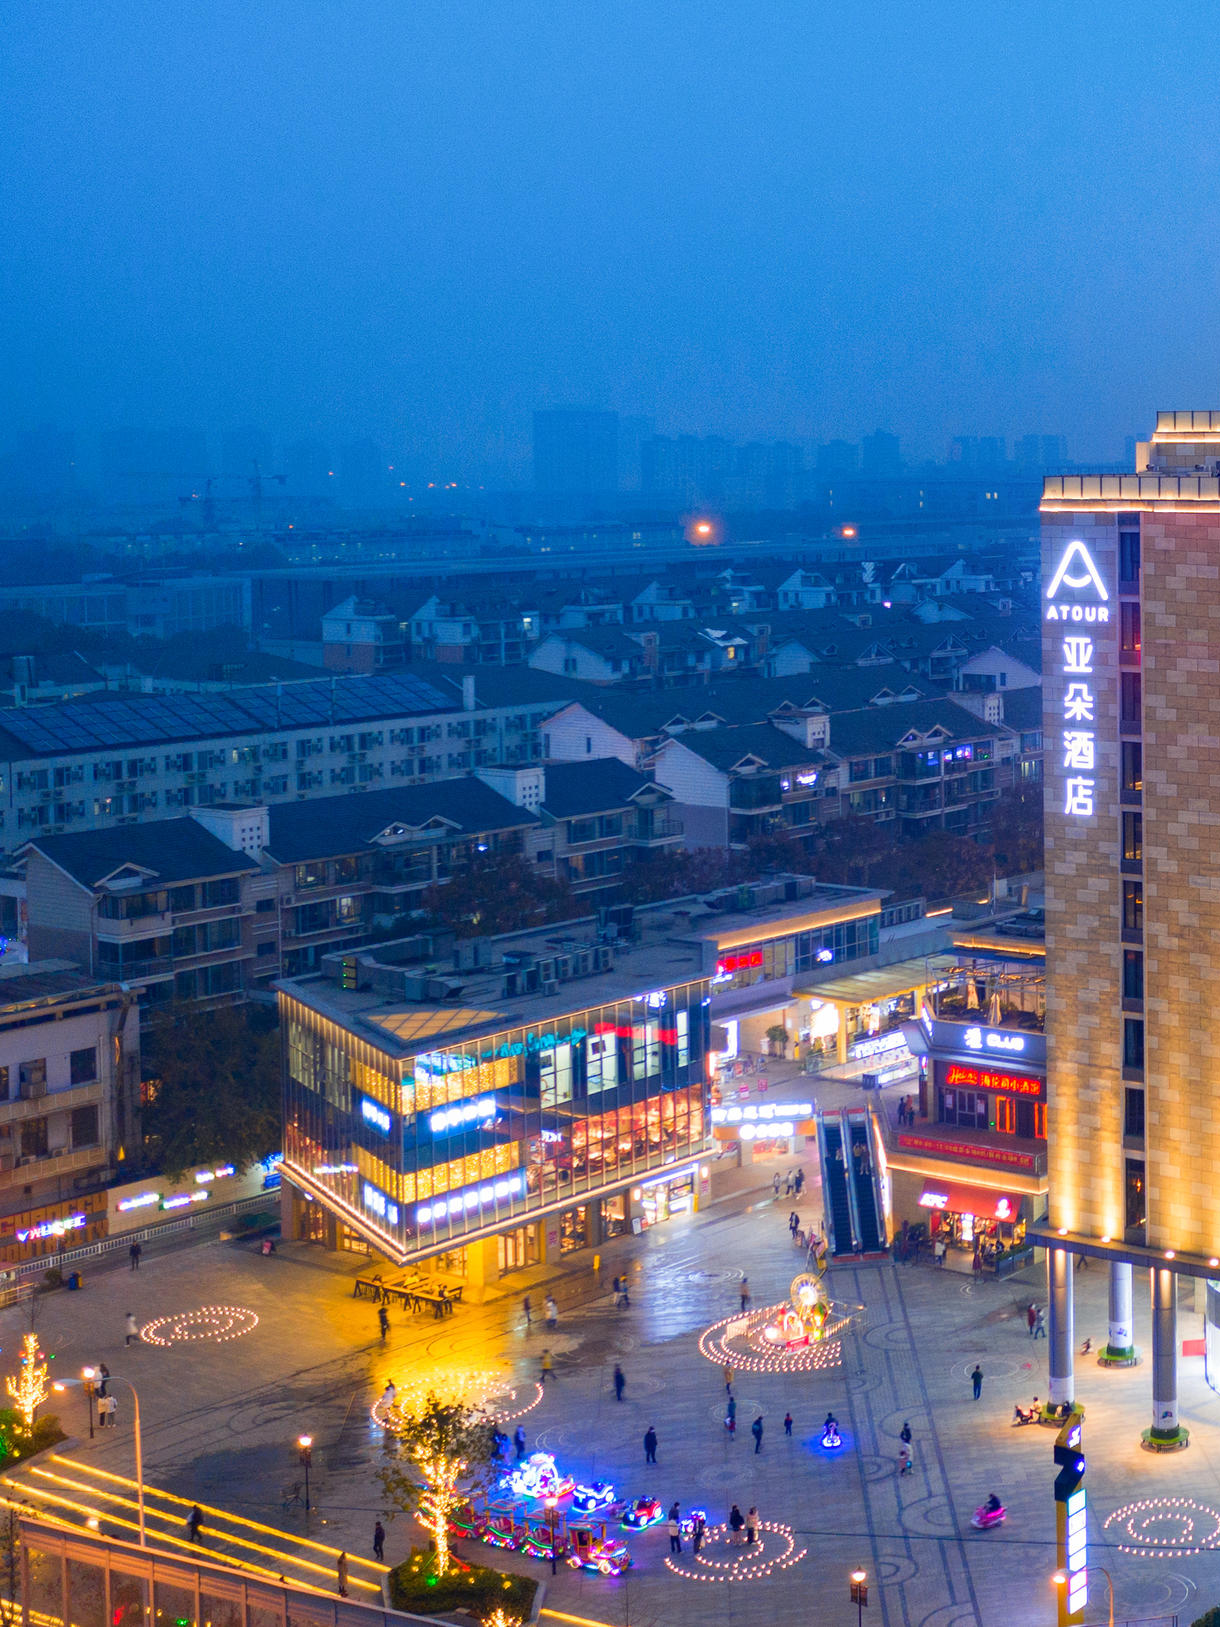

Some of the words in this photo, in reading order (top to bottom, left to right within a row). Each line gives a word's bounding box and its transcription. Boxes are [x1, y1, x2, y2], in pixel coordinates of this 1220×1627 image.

[1046, 605, 1110, 622] ATOUR
[1062, 636, 1096, 817] 亚朵酒店
[986, 1033, 1025, 1051] CLUB
[919, 1193, 948, 1209] KFC
